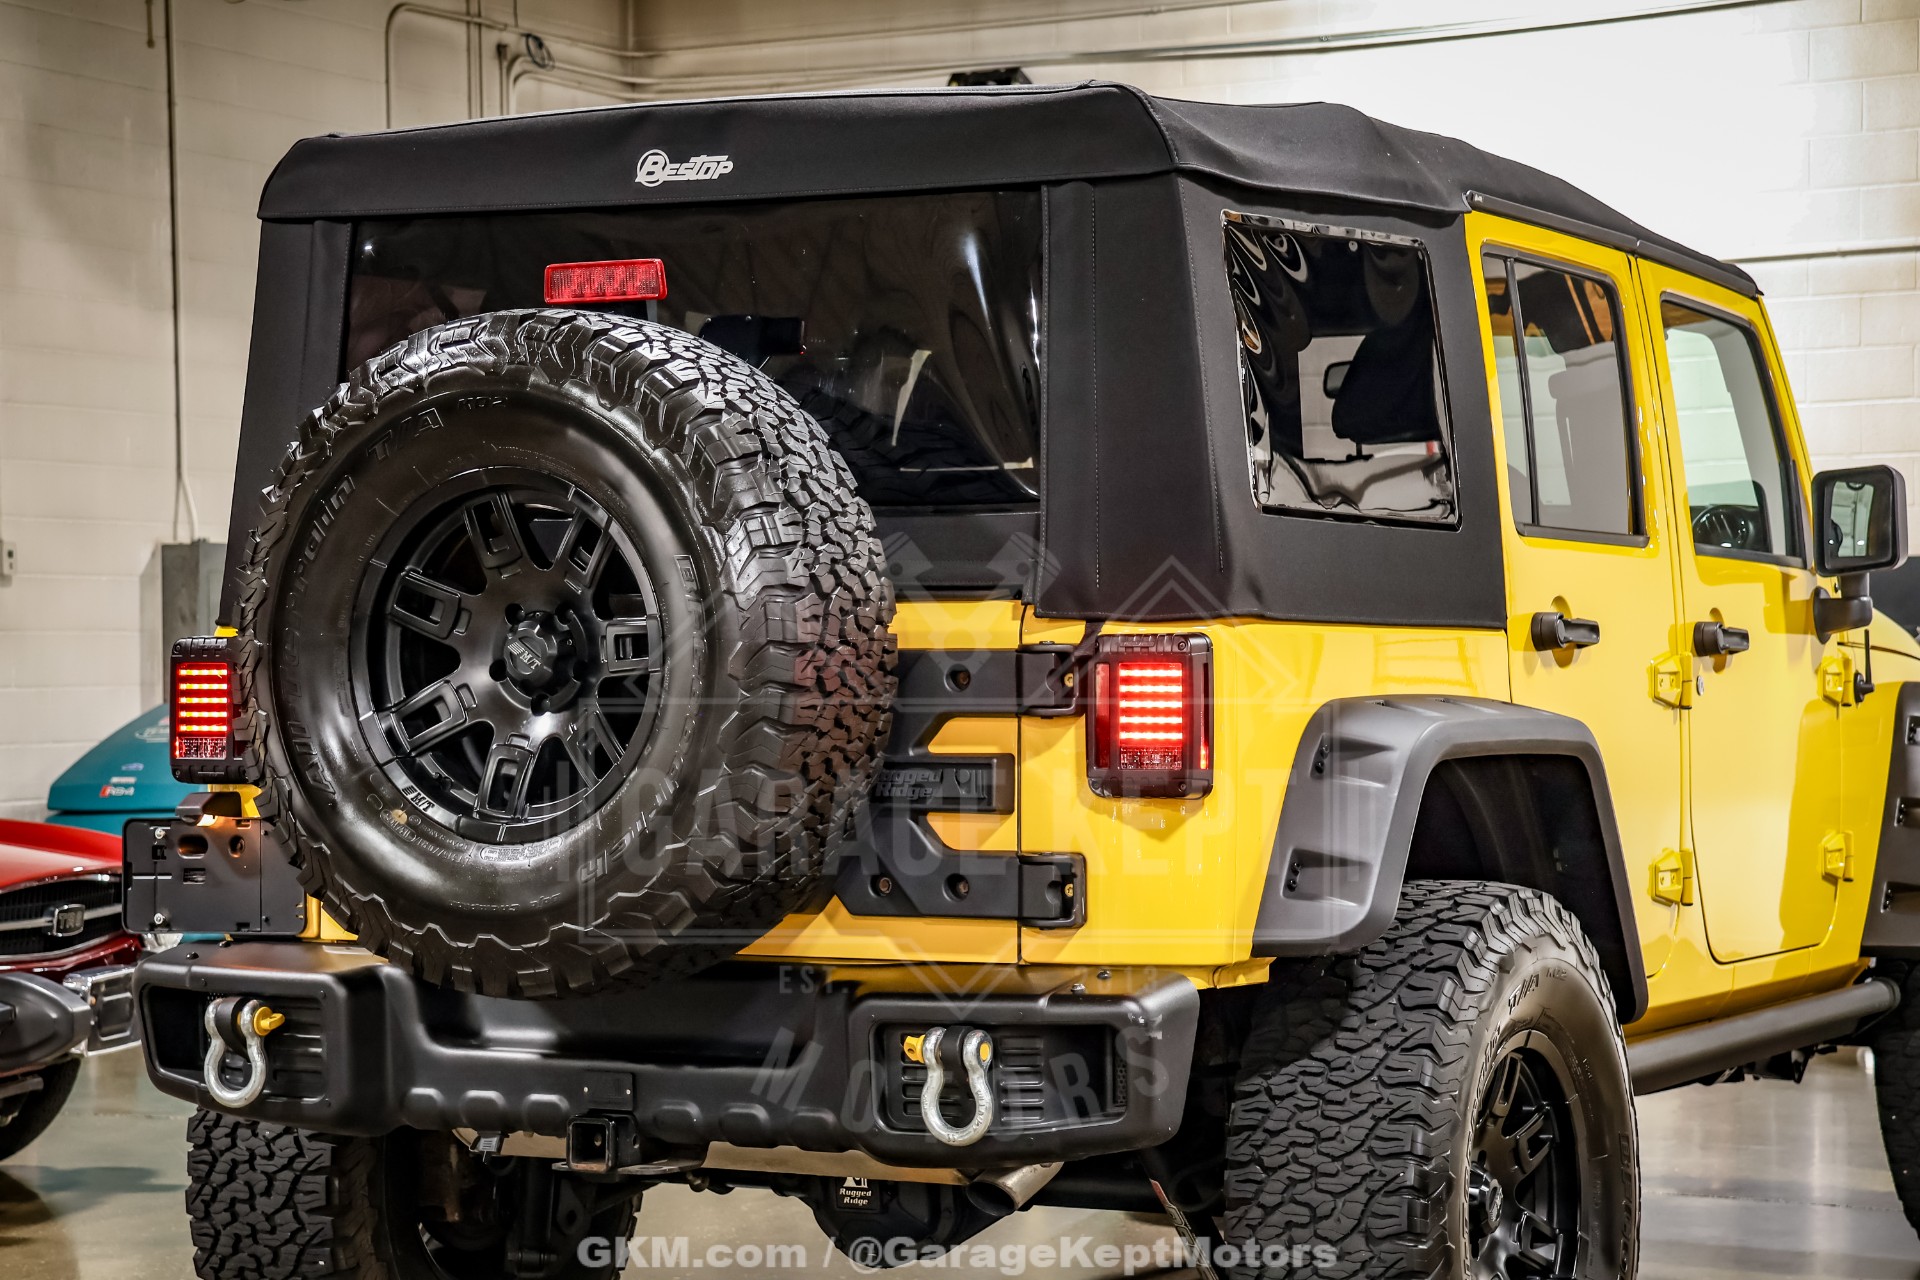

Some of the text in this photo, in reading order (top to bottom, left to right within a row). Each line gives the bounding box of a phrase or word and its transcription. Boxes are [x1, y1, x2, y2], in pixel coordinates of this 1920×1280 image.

[366, 407, 444, 461] T/A
[520, 650, 541, 669] M/T
[875, 782, 933, 800] Ridge
[411, 793, 435, 813] M/T
[839, 1187, 872, 1198] Rugged
[843, 1196, 869, 1207] Ridge
